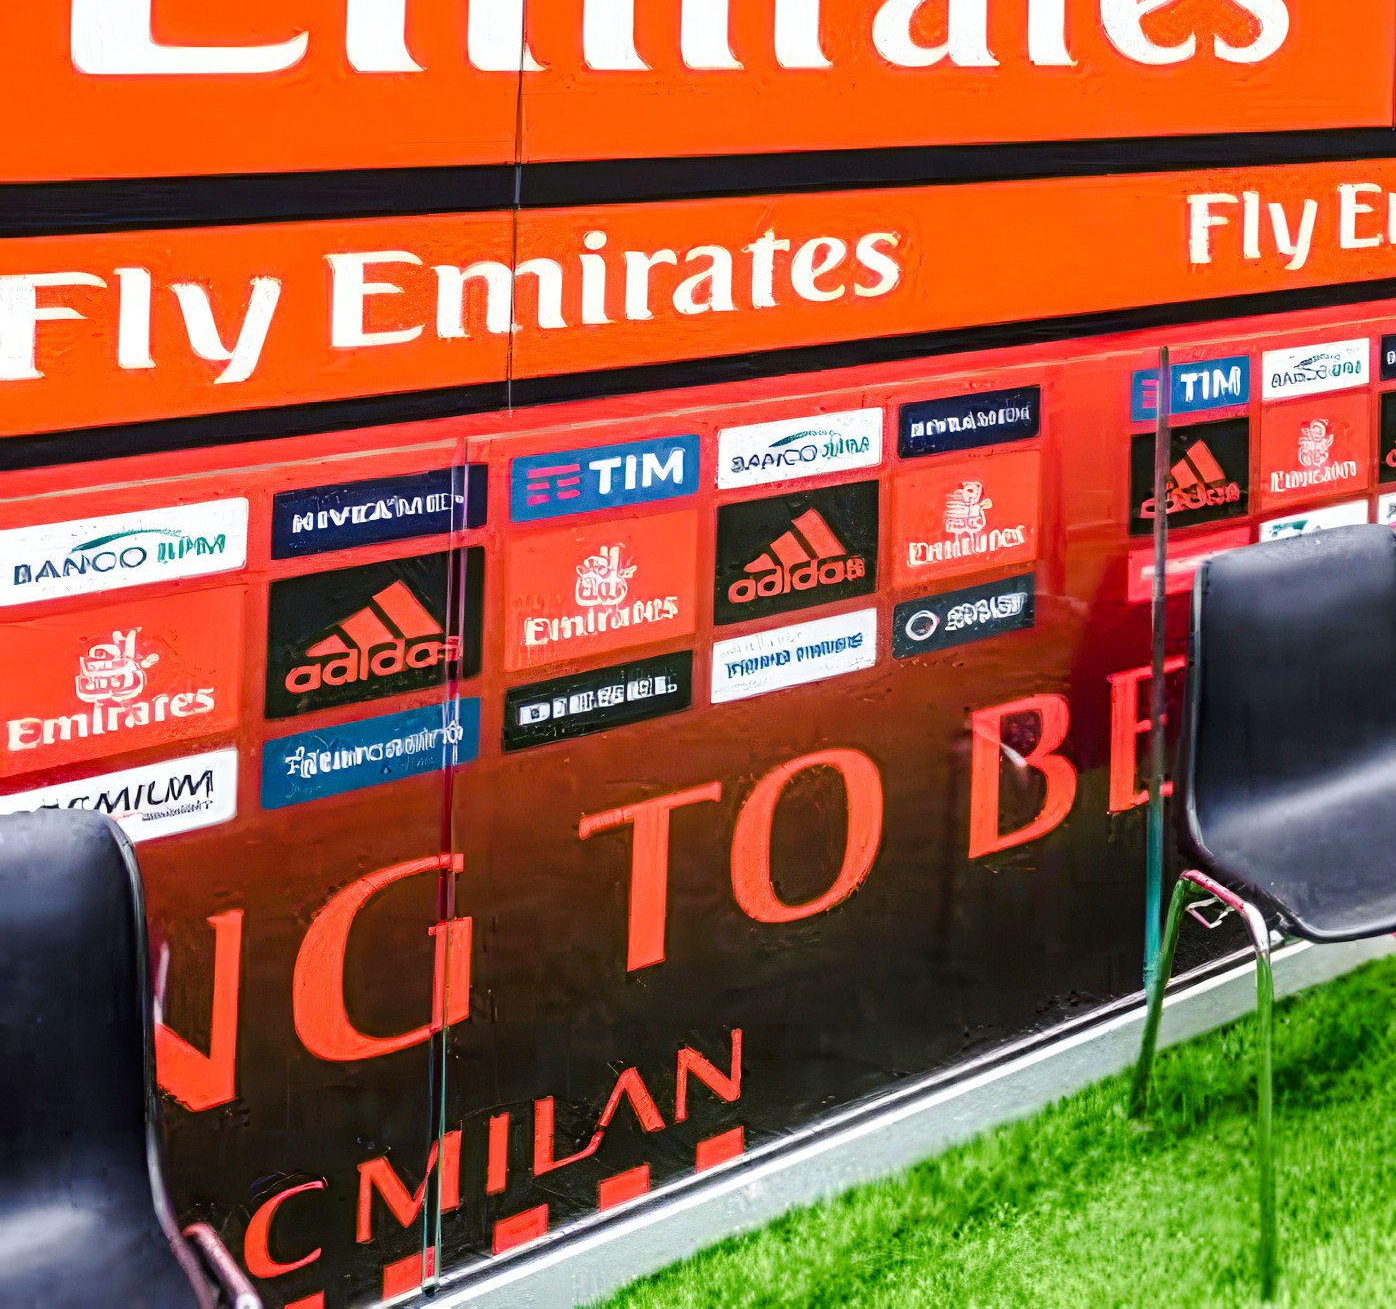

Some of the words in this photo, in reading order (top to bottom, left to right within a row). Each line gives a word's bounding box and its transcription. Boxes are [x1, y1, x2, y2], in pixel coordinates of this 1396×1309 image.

[1187, 193, 1319, 271] Fly
[0, 268, 282, 385] Fly
[322, 228, 903, 348] Emirates
[1181, 366, 1241, 402] TIM
[589, 447, 686, 494] TIM
[155, 854, 472, 1111] NG
[578, 749, 884, 972] TO
[968, 657, 1187, 860] BE
[244, 1029, 744, 1279] CMILAN
